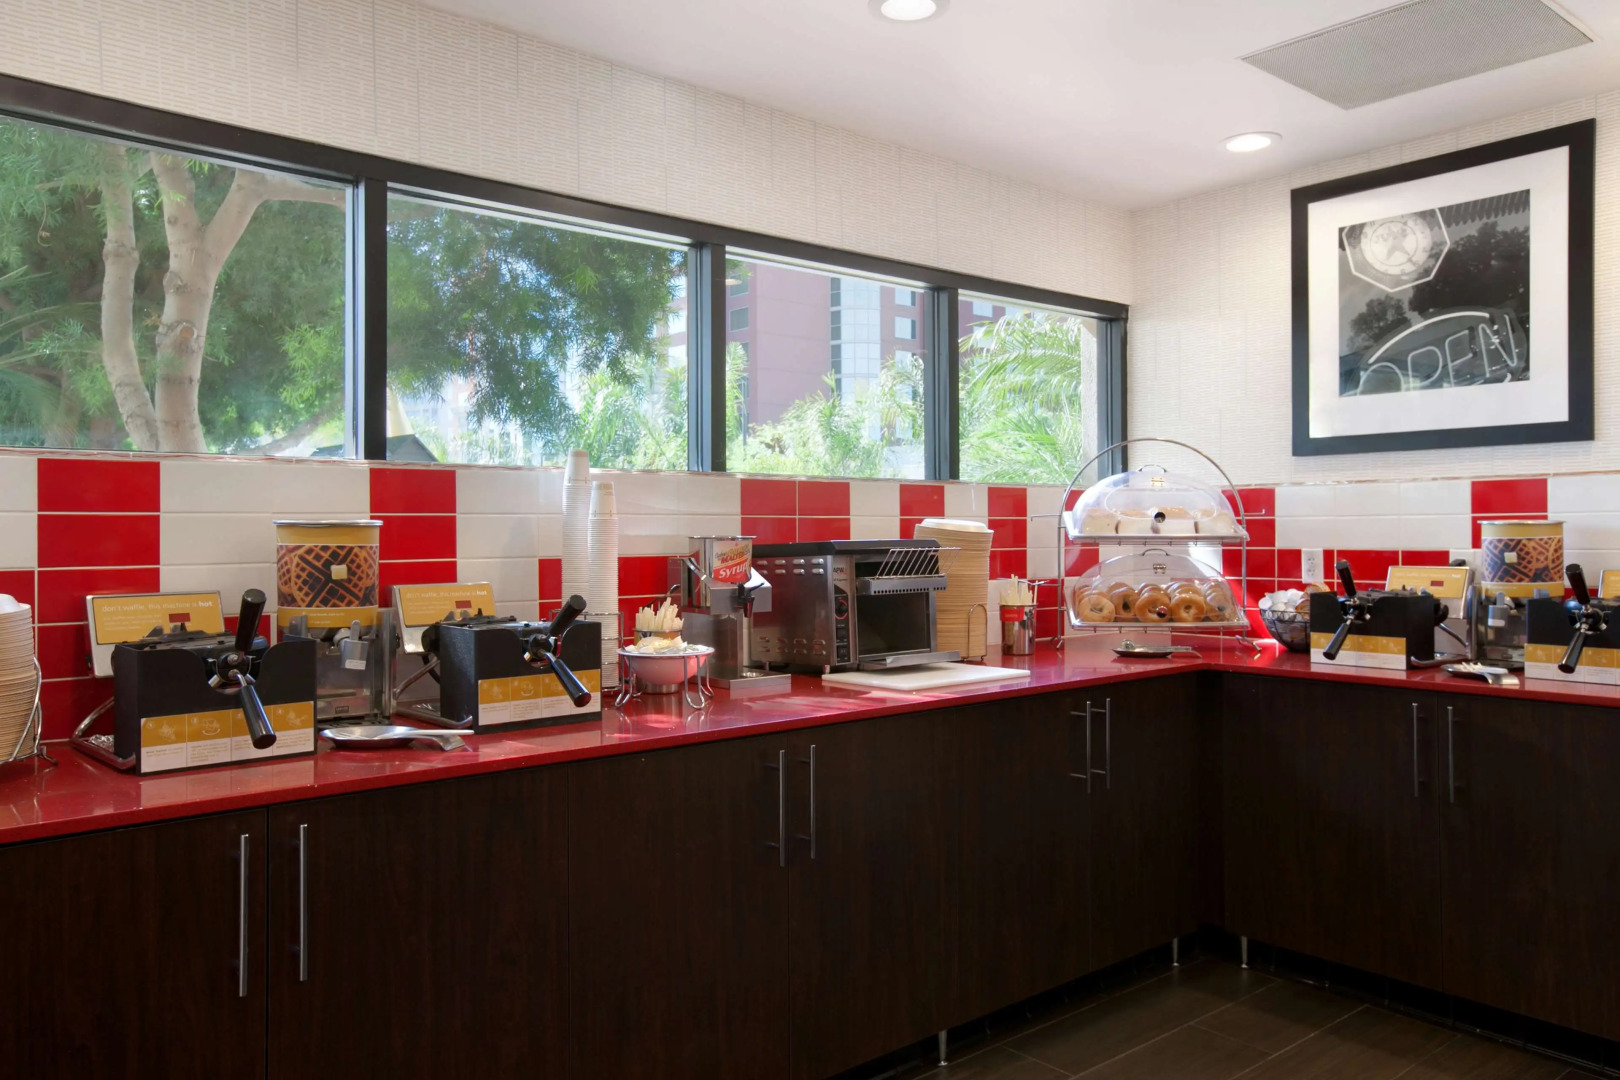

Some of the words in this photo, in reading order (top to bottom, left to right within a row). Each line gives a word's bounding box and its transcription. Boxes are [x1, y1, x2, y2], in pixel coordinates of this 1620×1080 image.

[1357, 314, 1517, 395] OPEN
[718, 562, 747, 579] Syrup
[162, 601, 190, 609] machine
